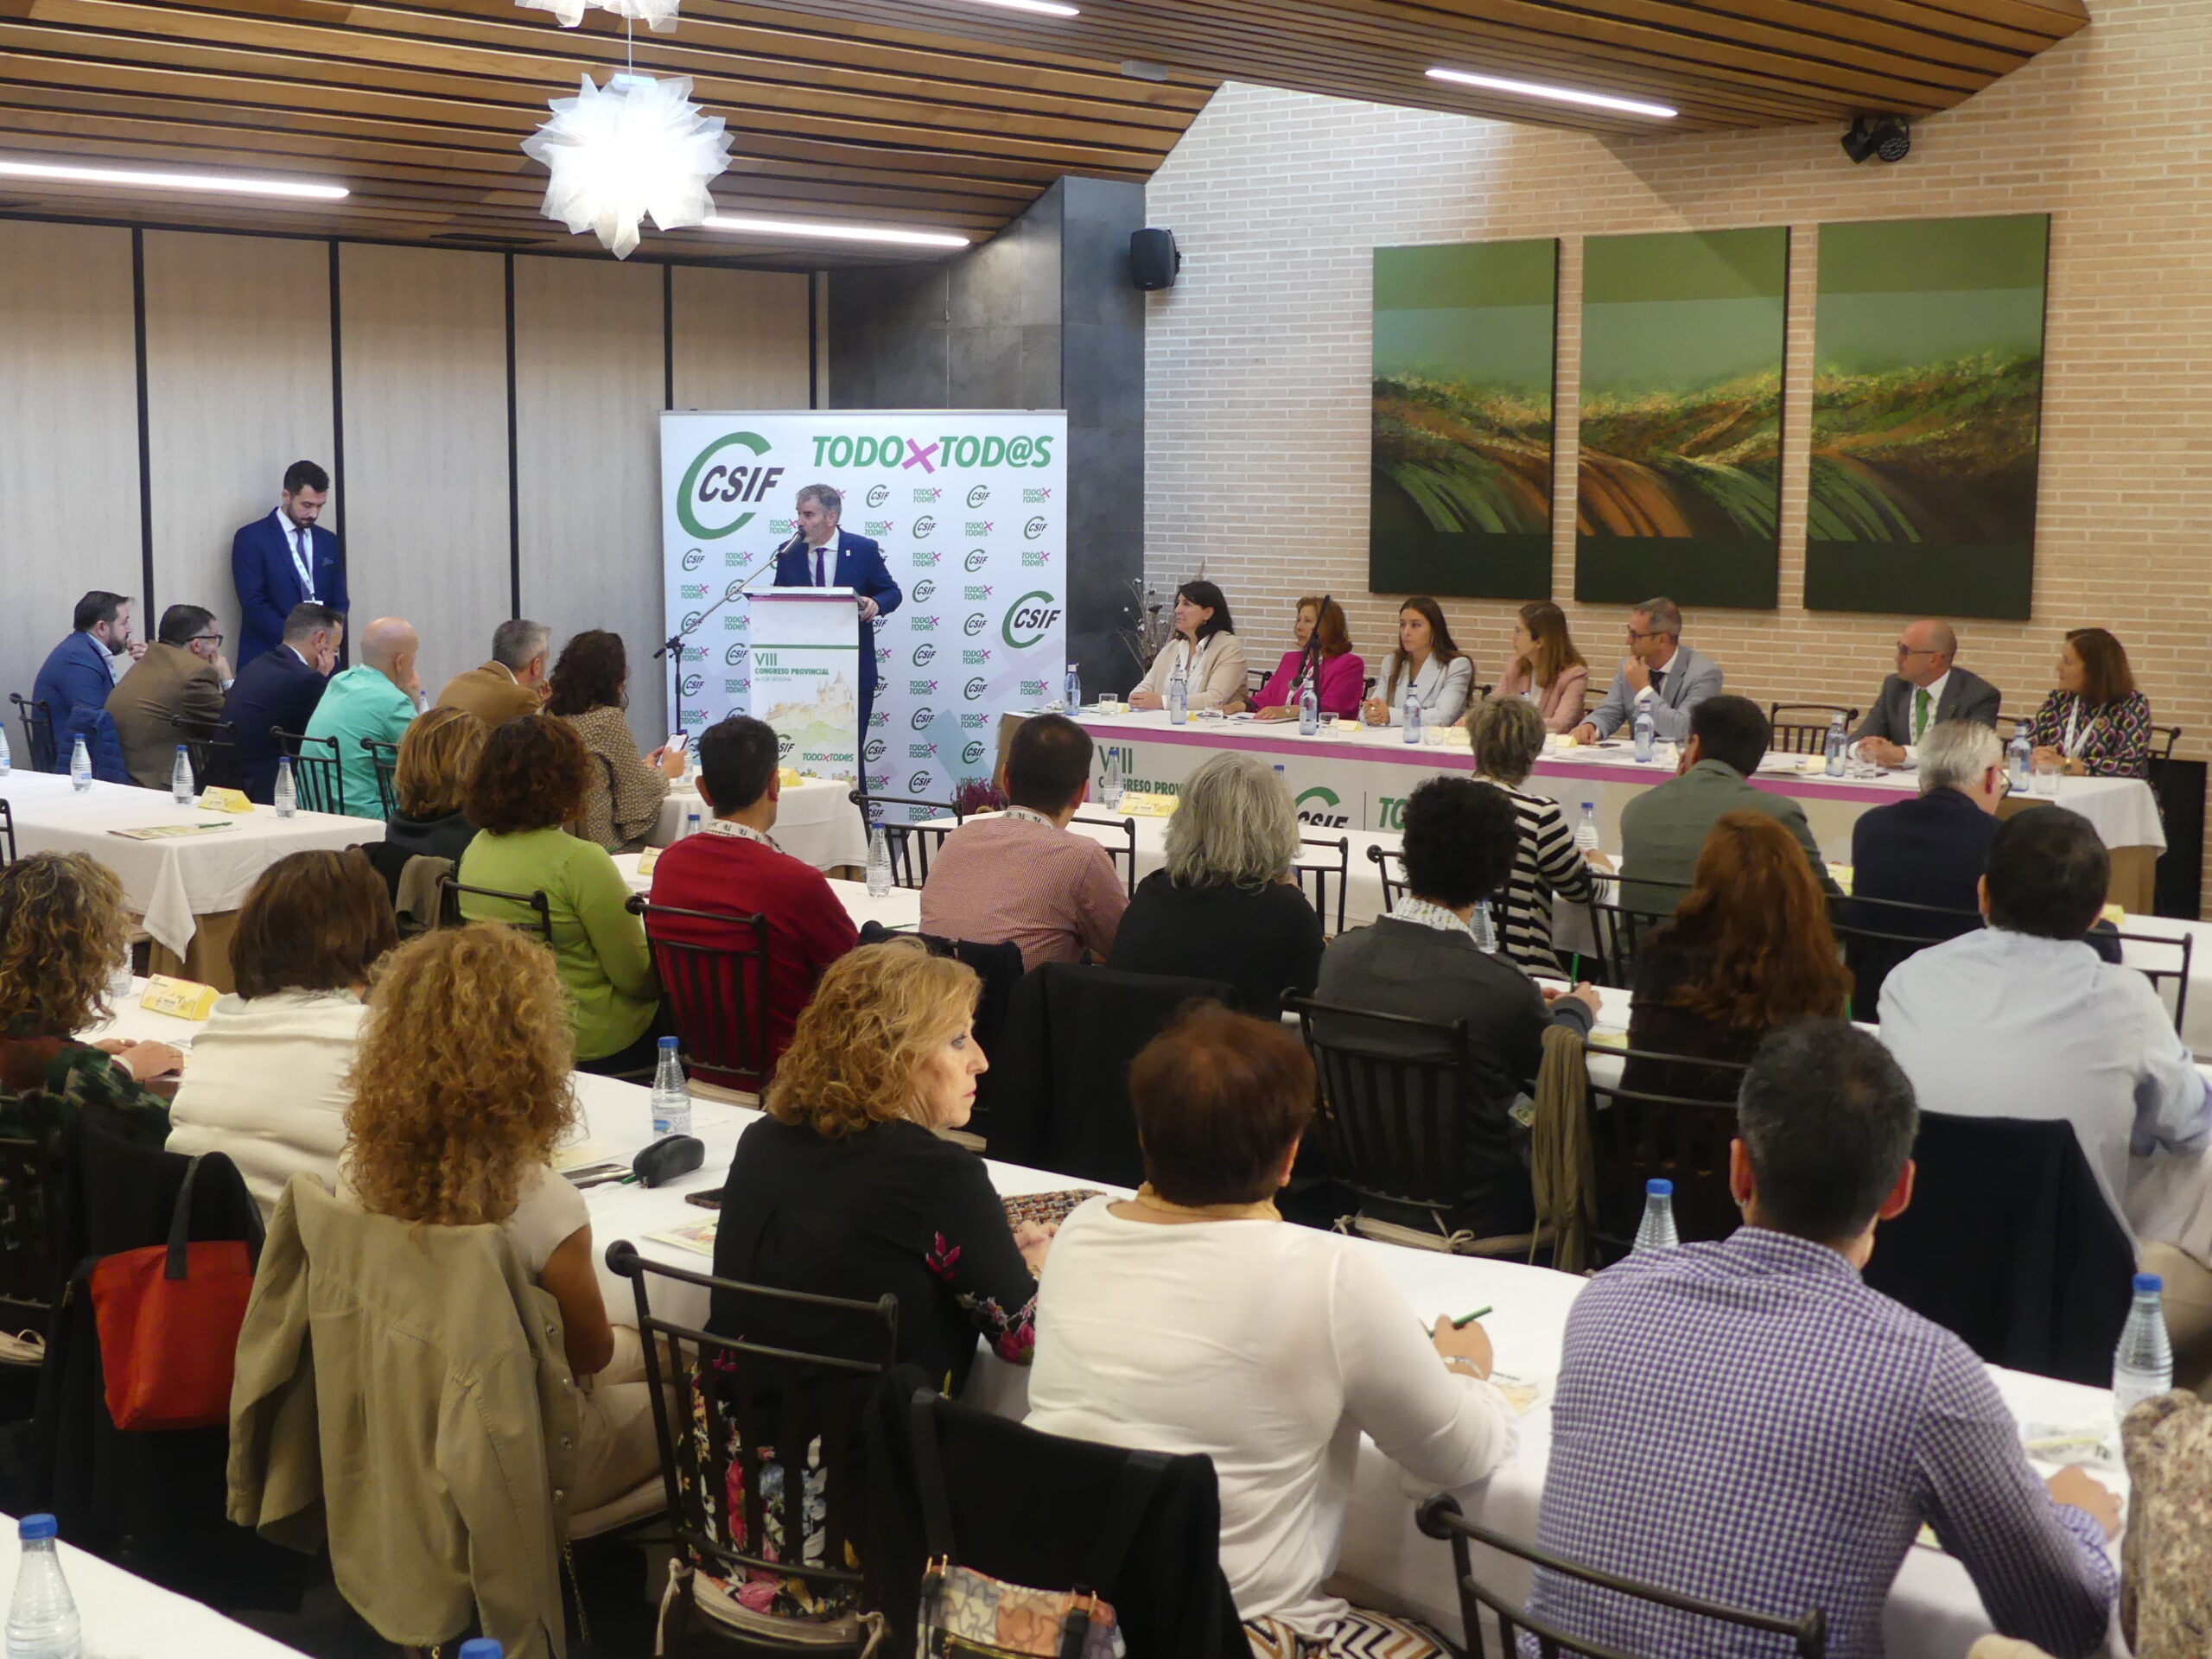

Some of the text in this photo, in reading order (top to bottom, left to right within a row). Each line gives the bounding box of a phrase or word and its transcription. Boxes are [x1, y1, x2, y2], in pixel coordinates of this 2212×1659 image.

[699, 465, 785, 502] CSIF
[870, 492, 890, 500] CSIF
[1014, 608, 1061, 629] CSIF
[968, 620, 987, 628] CSIF
[917, 651, 937, 659] CSIF
[754, 653, 778, 666] VIII
[686, 681, 704, 690] CSIF
[915, 715, 934, 723] CSIF
[913, 778, 932, 786] CSIF
